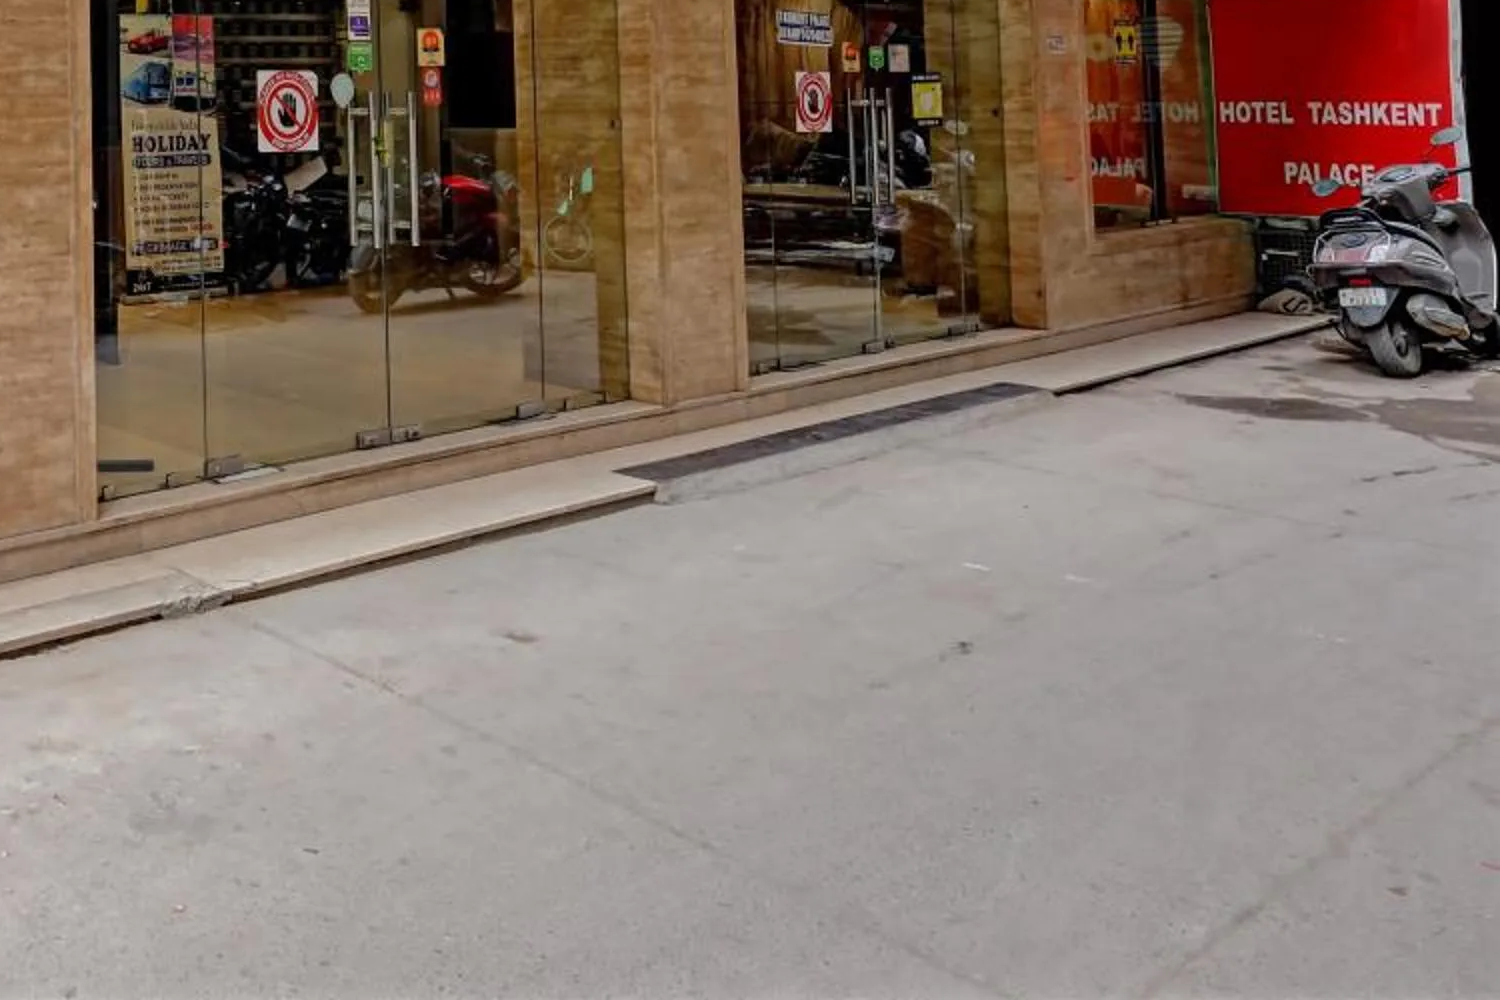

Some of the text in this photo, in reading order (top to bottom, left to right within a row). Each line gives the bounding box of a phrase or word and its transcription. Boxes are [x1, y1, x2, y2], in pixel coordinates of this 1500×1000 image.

[1219, 101, 1442, 127] HOTEL TASHKENT
[132, 132, 211, 153] HOLIDAY
